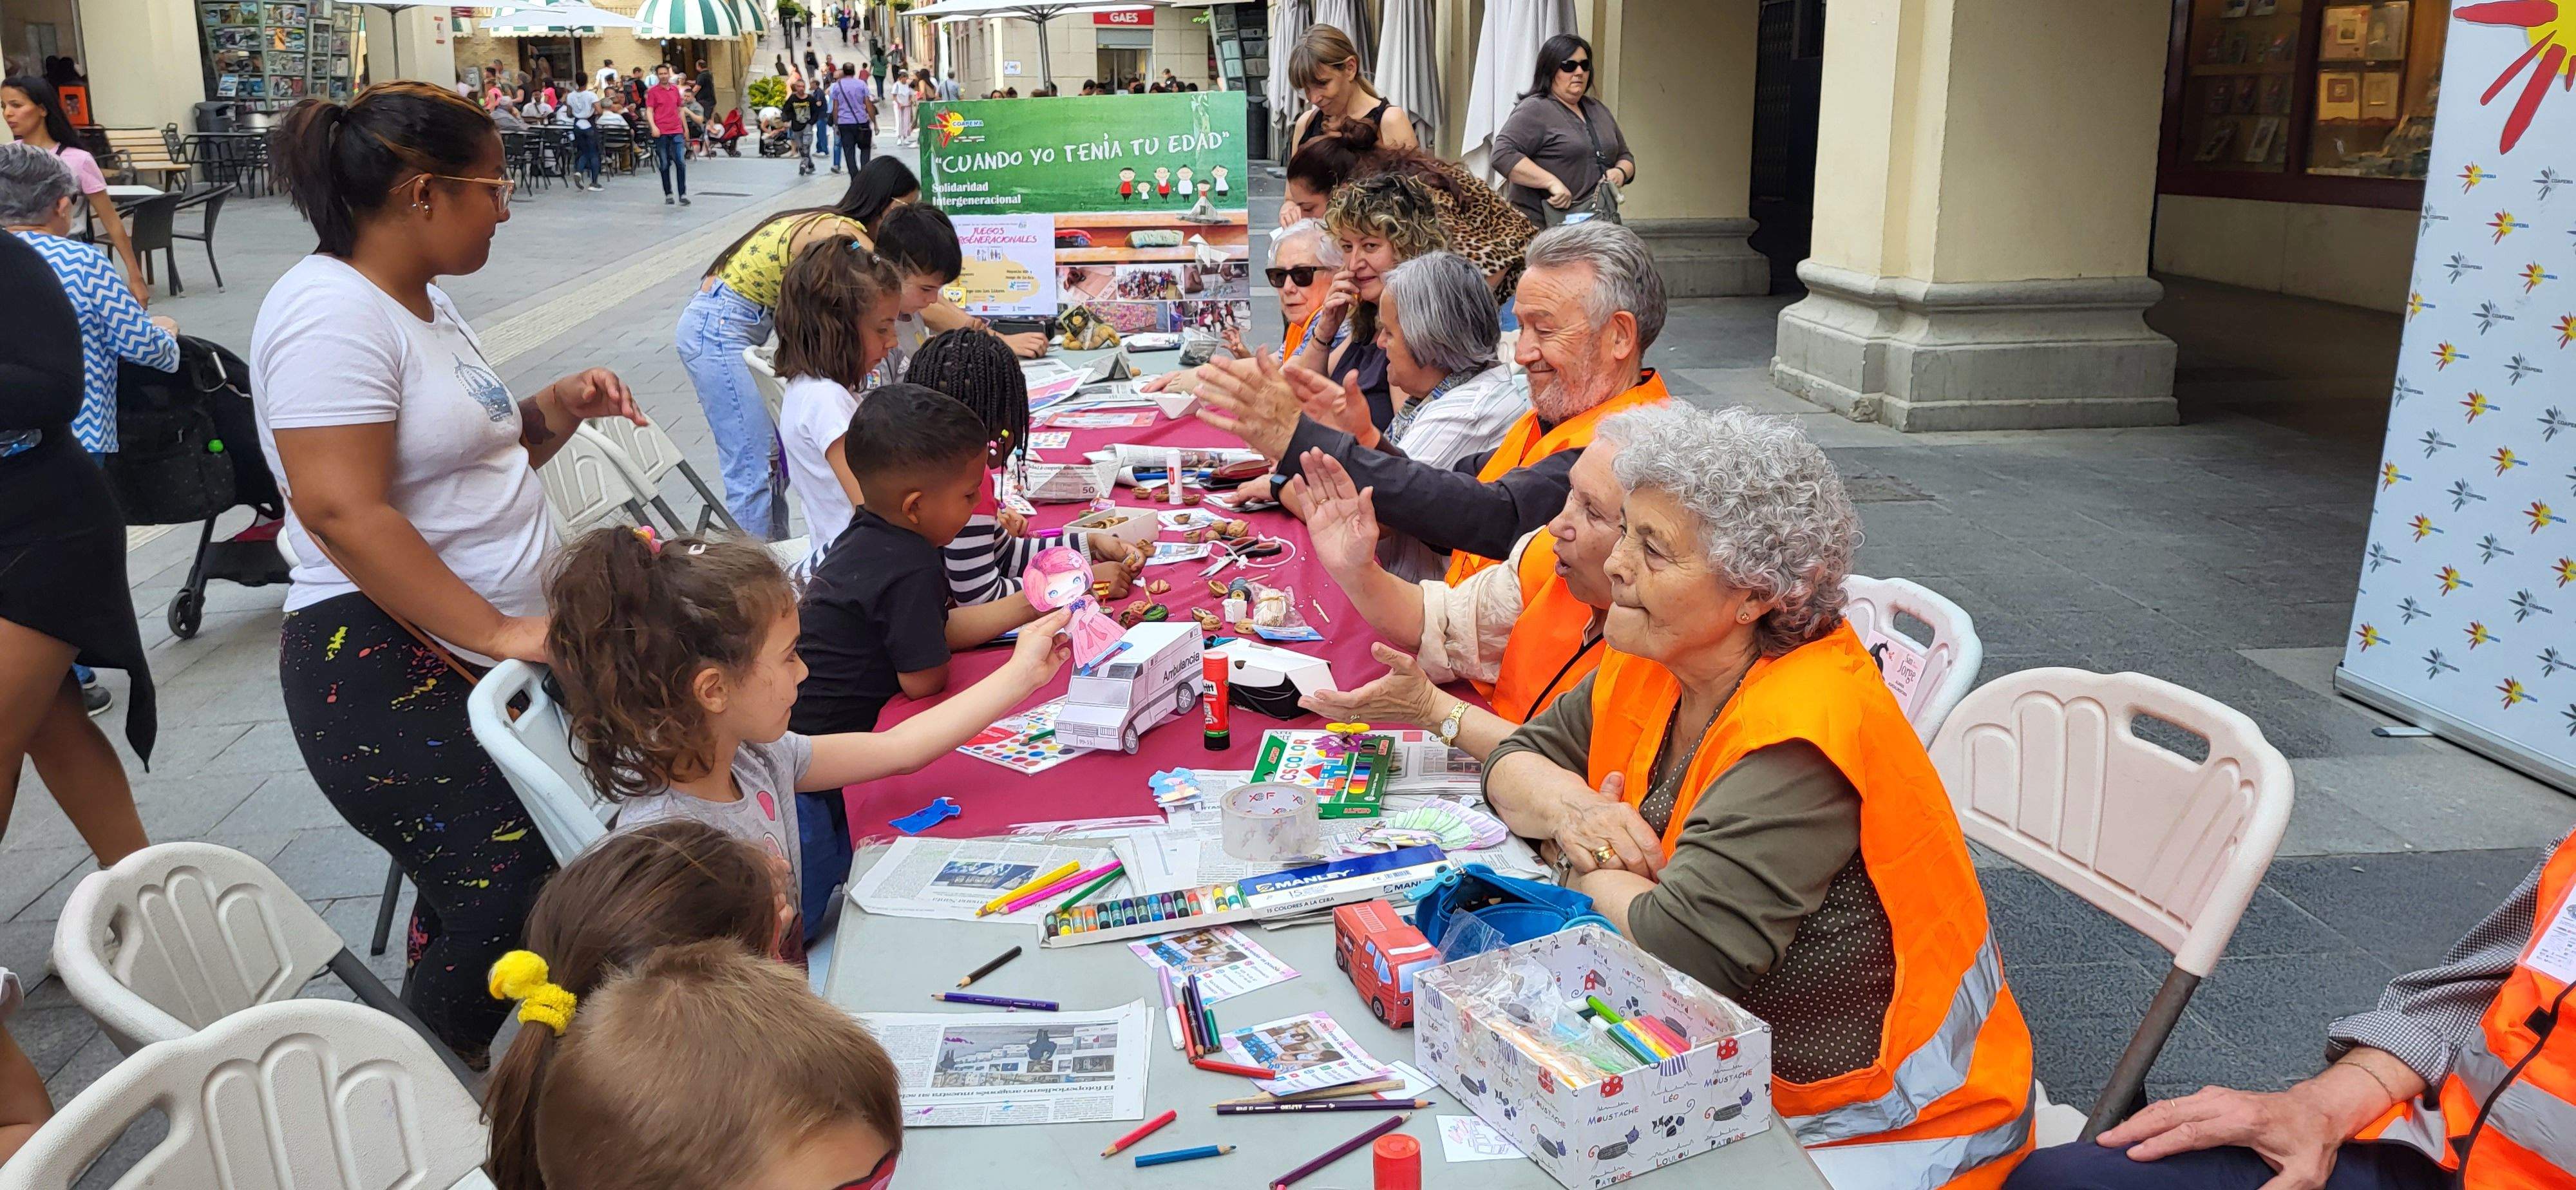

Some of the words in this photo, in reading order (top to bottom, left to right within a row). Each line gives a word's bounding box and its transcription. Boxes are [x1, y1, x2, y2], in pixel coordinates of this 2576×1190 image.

[1110, 12, 1139, 23] GAES
[1030, 147, 1055, 165] YO
[1130, 137, 1160, 155] TU
[931, 182, 989, 193] Solidaridad
[933, 194, 1022, 207] Intergeneracional
[958, 235, 1037, 245] RGENERACIONALES
[972, 227, 1005, 237] JUEGOS
[2557, 419, 2576, 428] COAPE
[1162, 651, 1200, 684] Ambulancia
[1897, 660, 1916, 684] Jorge
[1280, 739, 1310, 783] CSCOLOR
[1276, 869, 1351, 889] MANLEY
[1394, 877, 1423, 891] MANL
[1274, 902, 1303, 912] COLORES
[1622, 968, 1646, 988] LOULOU
[1661, 989, 1689, 1014] PATOUNE
[1428, 1019, 1439, 1032] LÉO
[1501, 1073, 1513, 1088] LÉO
[1703, 1068, 1754, 1088] MOUSTACHE
[1663, 1093, 1679, 1104] LÉO
[1535, 1099, 1566, 1129] OUSTACHE
[1587, 1106, 1640, 1126] MOUSTACHE
[1710, 1131, 1747, 1150] PATOUNE
[1656, 1149, 1690, 1167] LOULOU
[1595, 1171, 1633, 1189] PATOUNE
